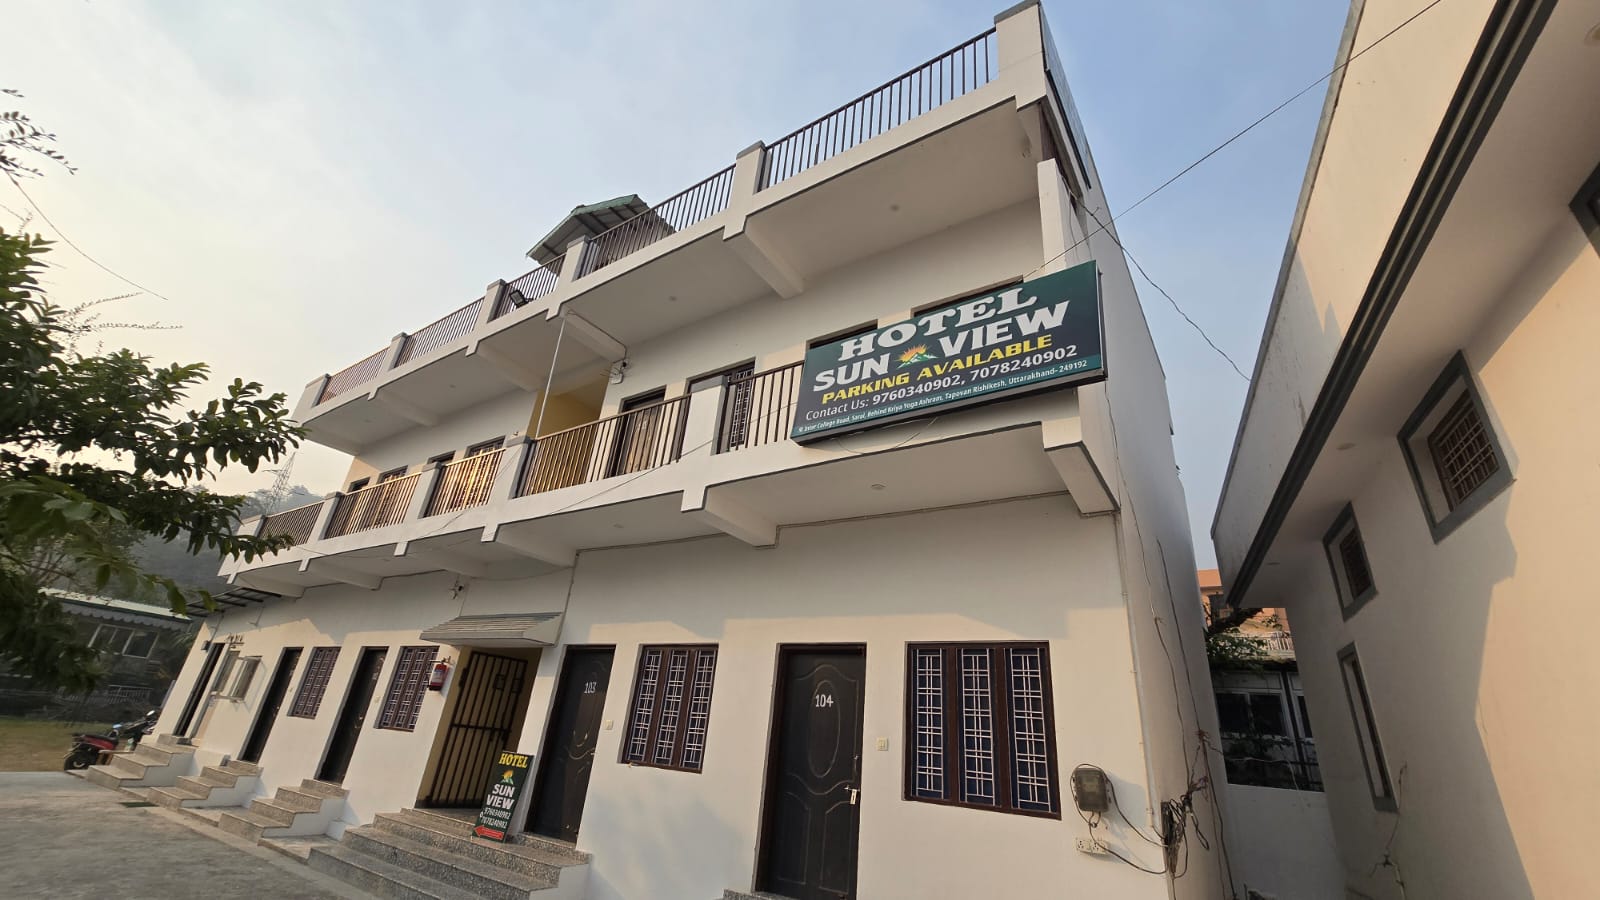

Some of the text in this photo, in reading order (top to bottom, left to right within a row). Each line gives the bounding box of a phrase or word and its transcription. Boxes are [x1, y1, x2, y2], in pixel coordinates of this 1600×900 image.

[838, 287, 1038, 362] HOTEL
[813, 300, 1070, 392] SUN VIEW
[822, 334, 1053, 404] PARKING AVAILABLE
[806, 344, 1078, 420] Contact Us: 9760340902, 7078240902
[583, 681, 597, 694] 103
[815, 694, 834, 708] 104
[498, 753, 528, 768] HOTEL
[492, 784, 515, 797] SUN
[486, 794, 515, 810] VIEW
